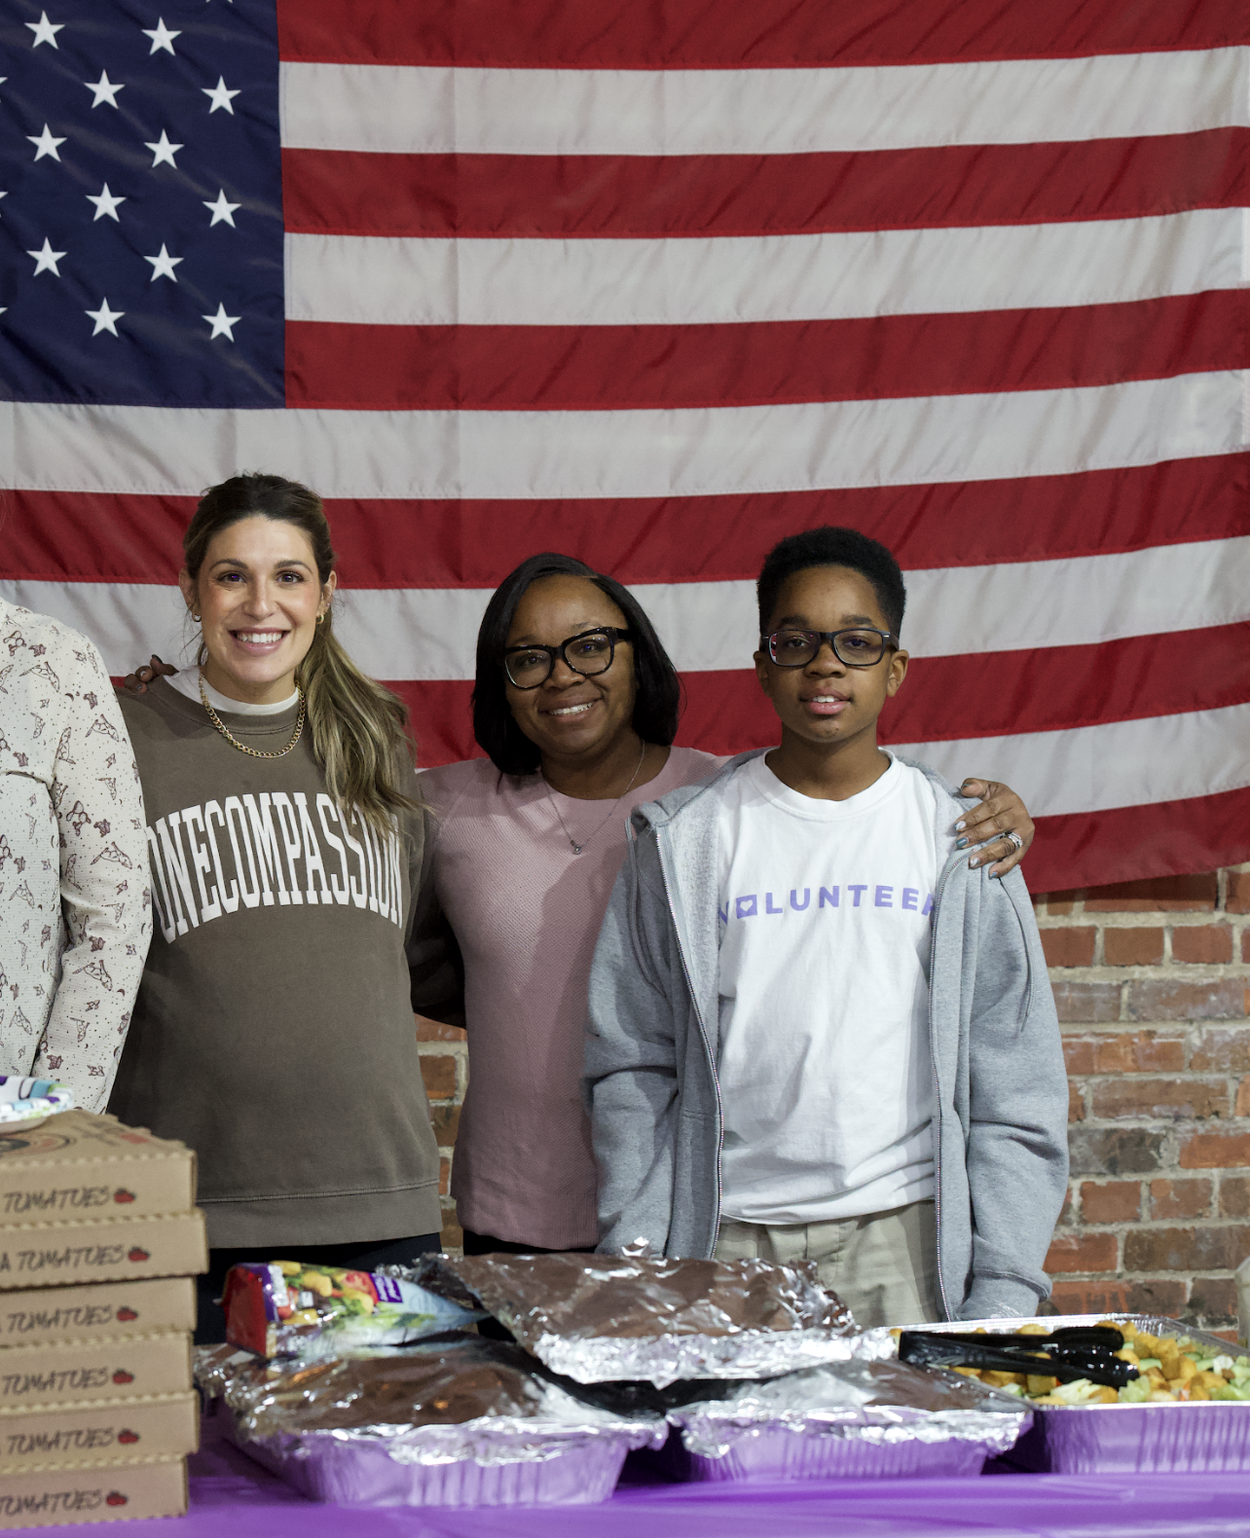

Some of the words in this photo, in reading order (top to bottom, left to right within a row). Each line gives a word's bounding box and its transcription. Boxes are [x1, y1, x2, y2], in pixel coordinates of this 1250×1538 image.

[4, 1186, 110, 1213] TOMATOES
[17, 1245, 124, 1271] TOMATOES
[8, 1305, 113, 1333] TOMATOES
[2, 1367, 109, 1395] TOMATOES
[7, 1427, 114, 1455] TOMATOES
